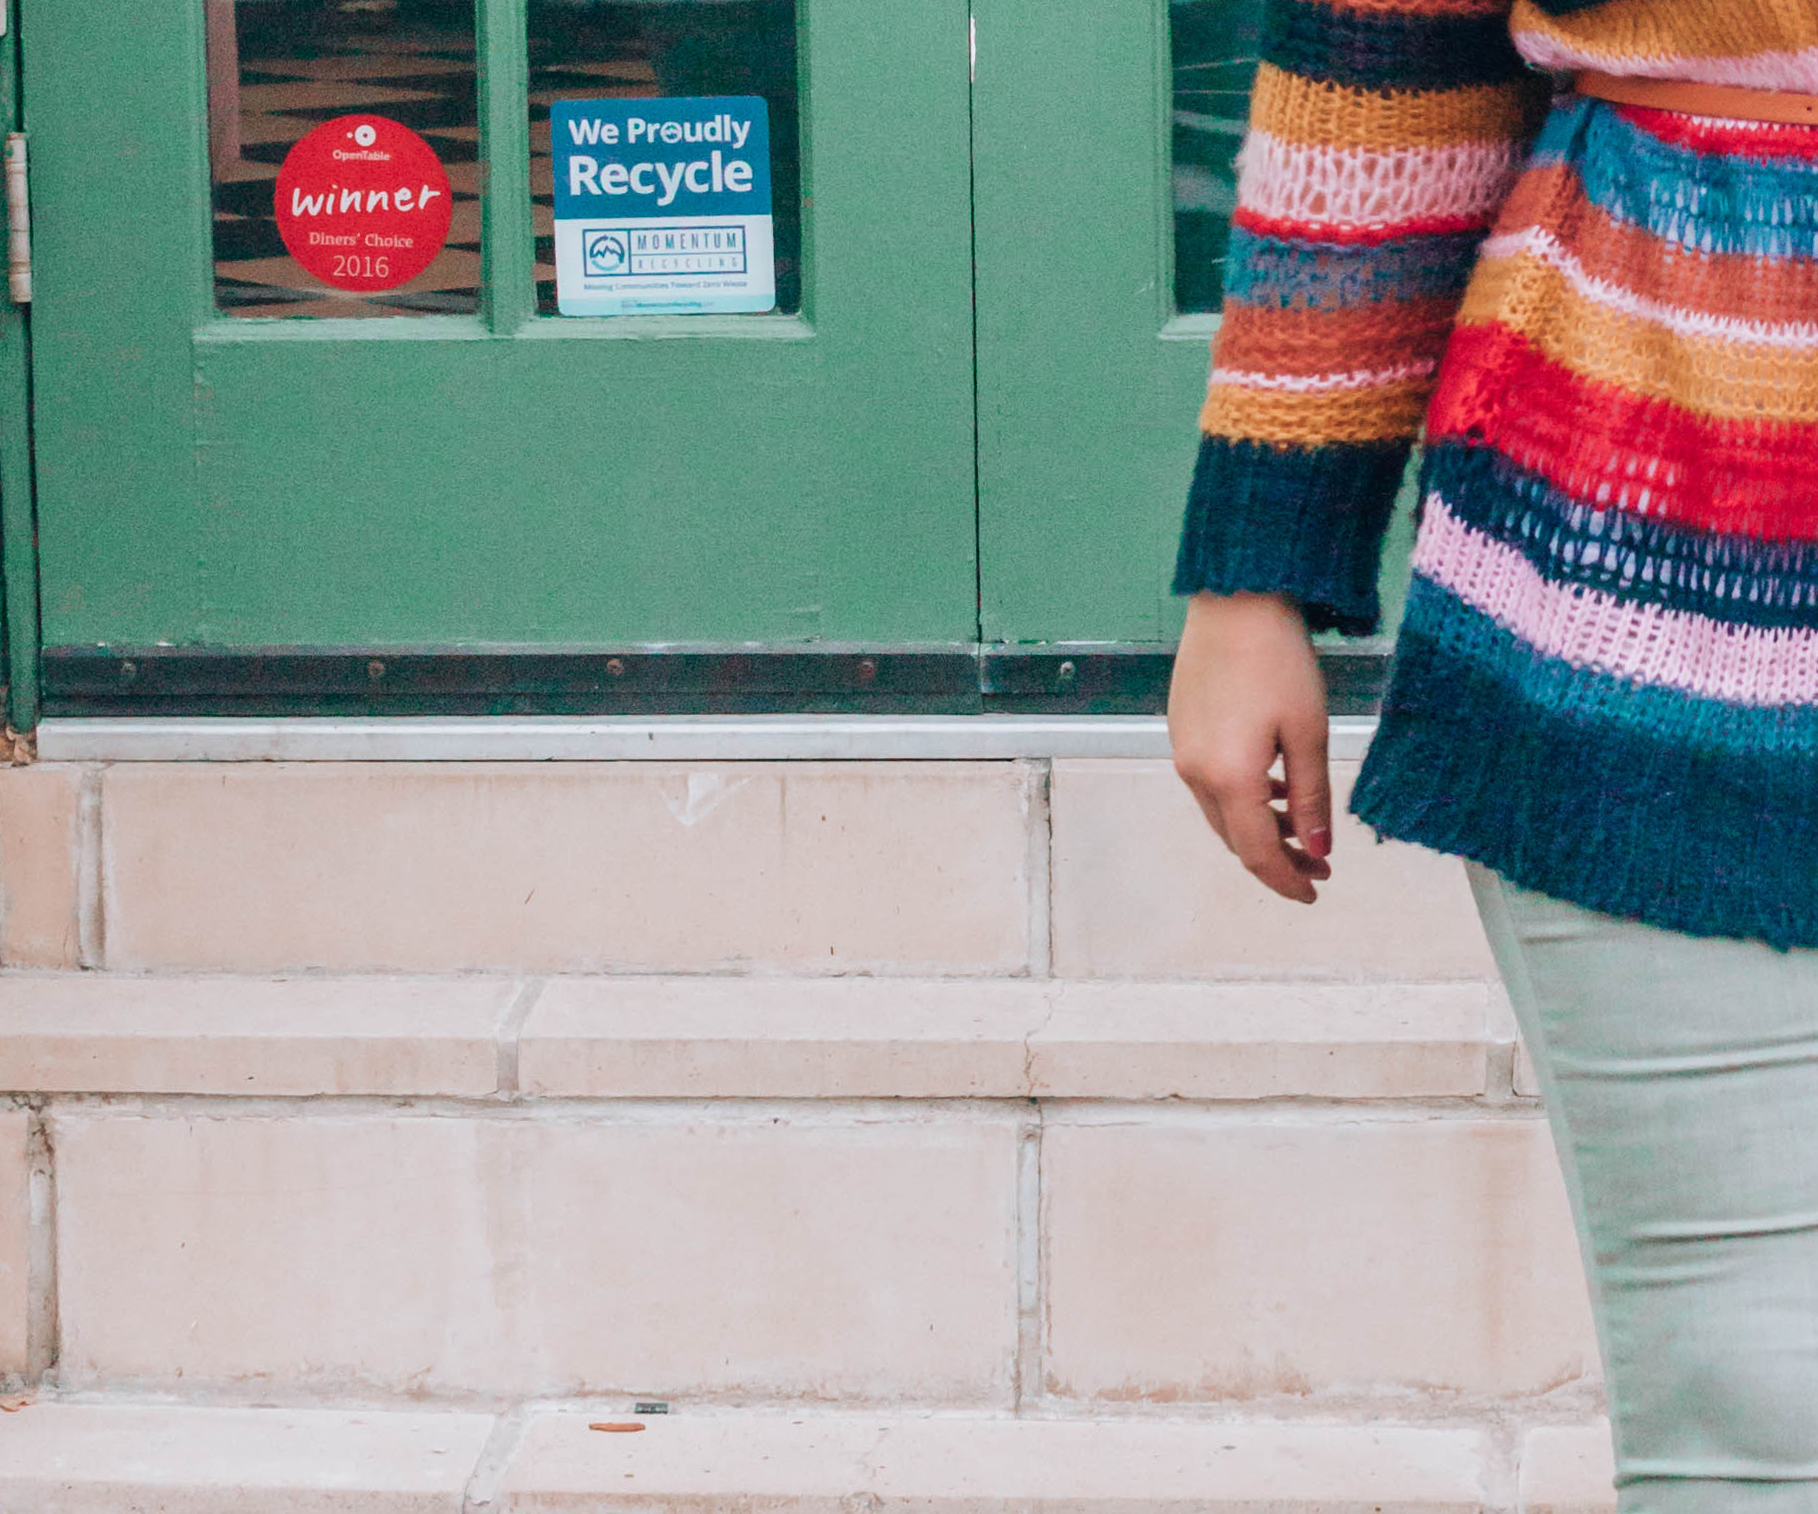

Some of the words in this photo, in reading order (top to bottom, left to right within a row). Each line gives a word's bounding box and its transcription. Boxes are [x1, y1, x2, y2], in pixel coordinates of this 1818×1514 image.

[568, 118, 620, 145] We
[627, 114, 752, 149] Proudly
[332, 149, 391, 163] OpenTable
[569, 150, 753, 207] Recycle
[292, 184, 442, 217] winner
[309, 231, 361, 246] Diners'
[364, 233, 414, 248] Choice
[637, 232, 737, 250] MOMENTUM
[333, 254, 390, 278] 2016
[639, 256, 738, 270] RECYCLING
